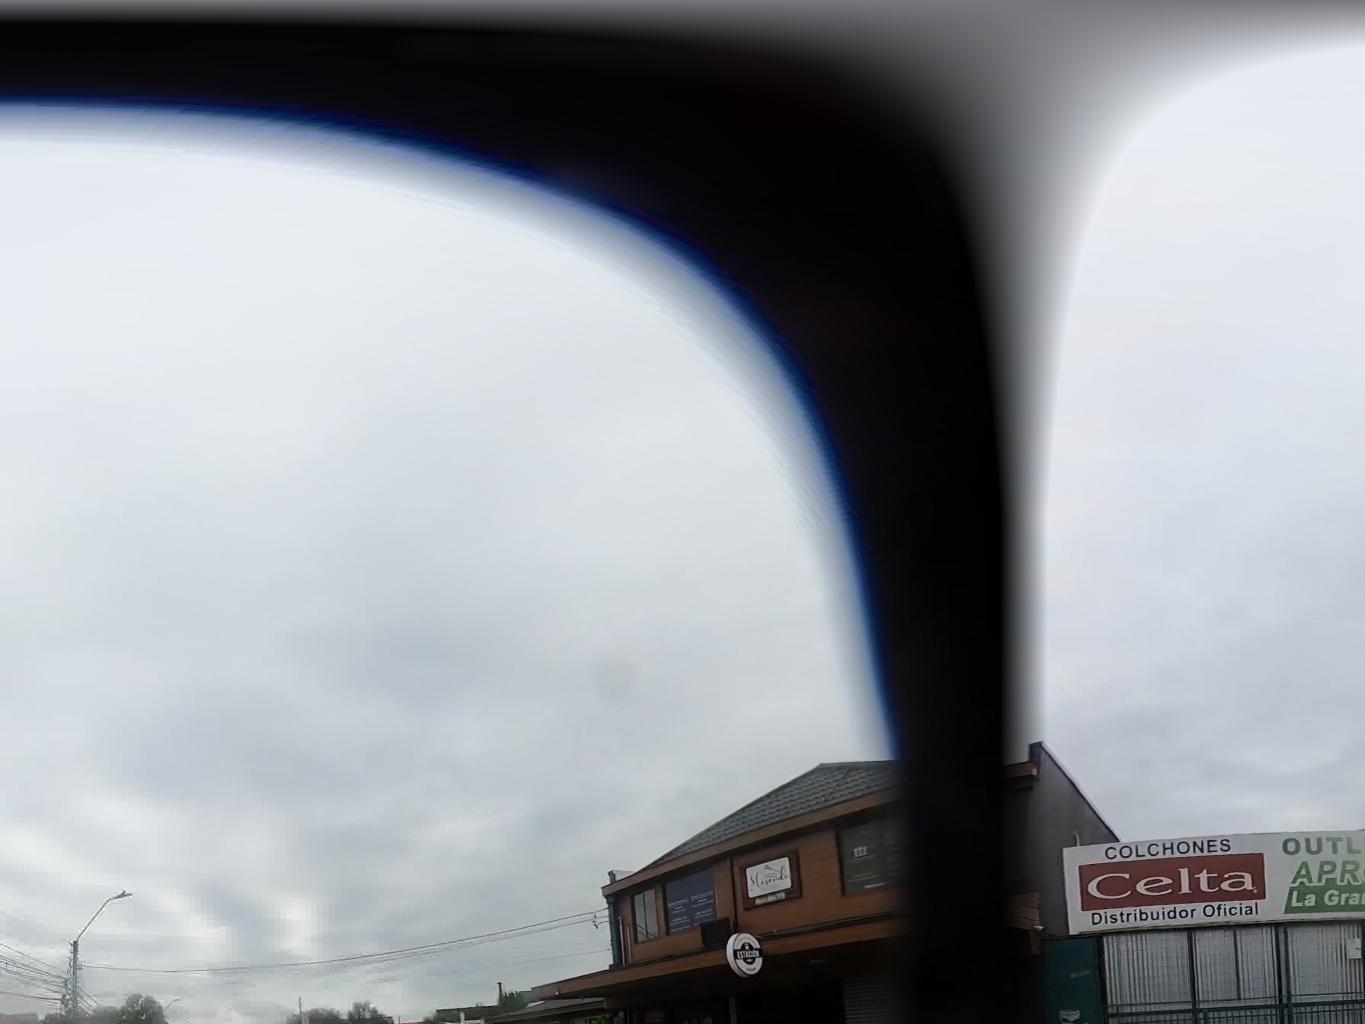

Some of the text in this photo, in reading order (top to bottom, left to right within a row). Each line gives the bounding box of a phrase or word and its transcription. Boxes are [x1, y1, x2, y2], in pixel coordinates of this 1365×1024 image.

[1105, 839, 1231, 860] COLCHONES
[1087, 868, 1258, 899] Celta
[1291, 890, 1316, 907] La
[1092, 902, 1259, 925] Distribuidor Oficial
